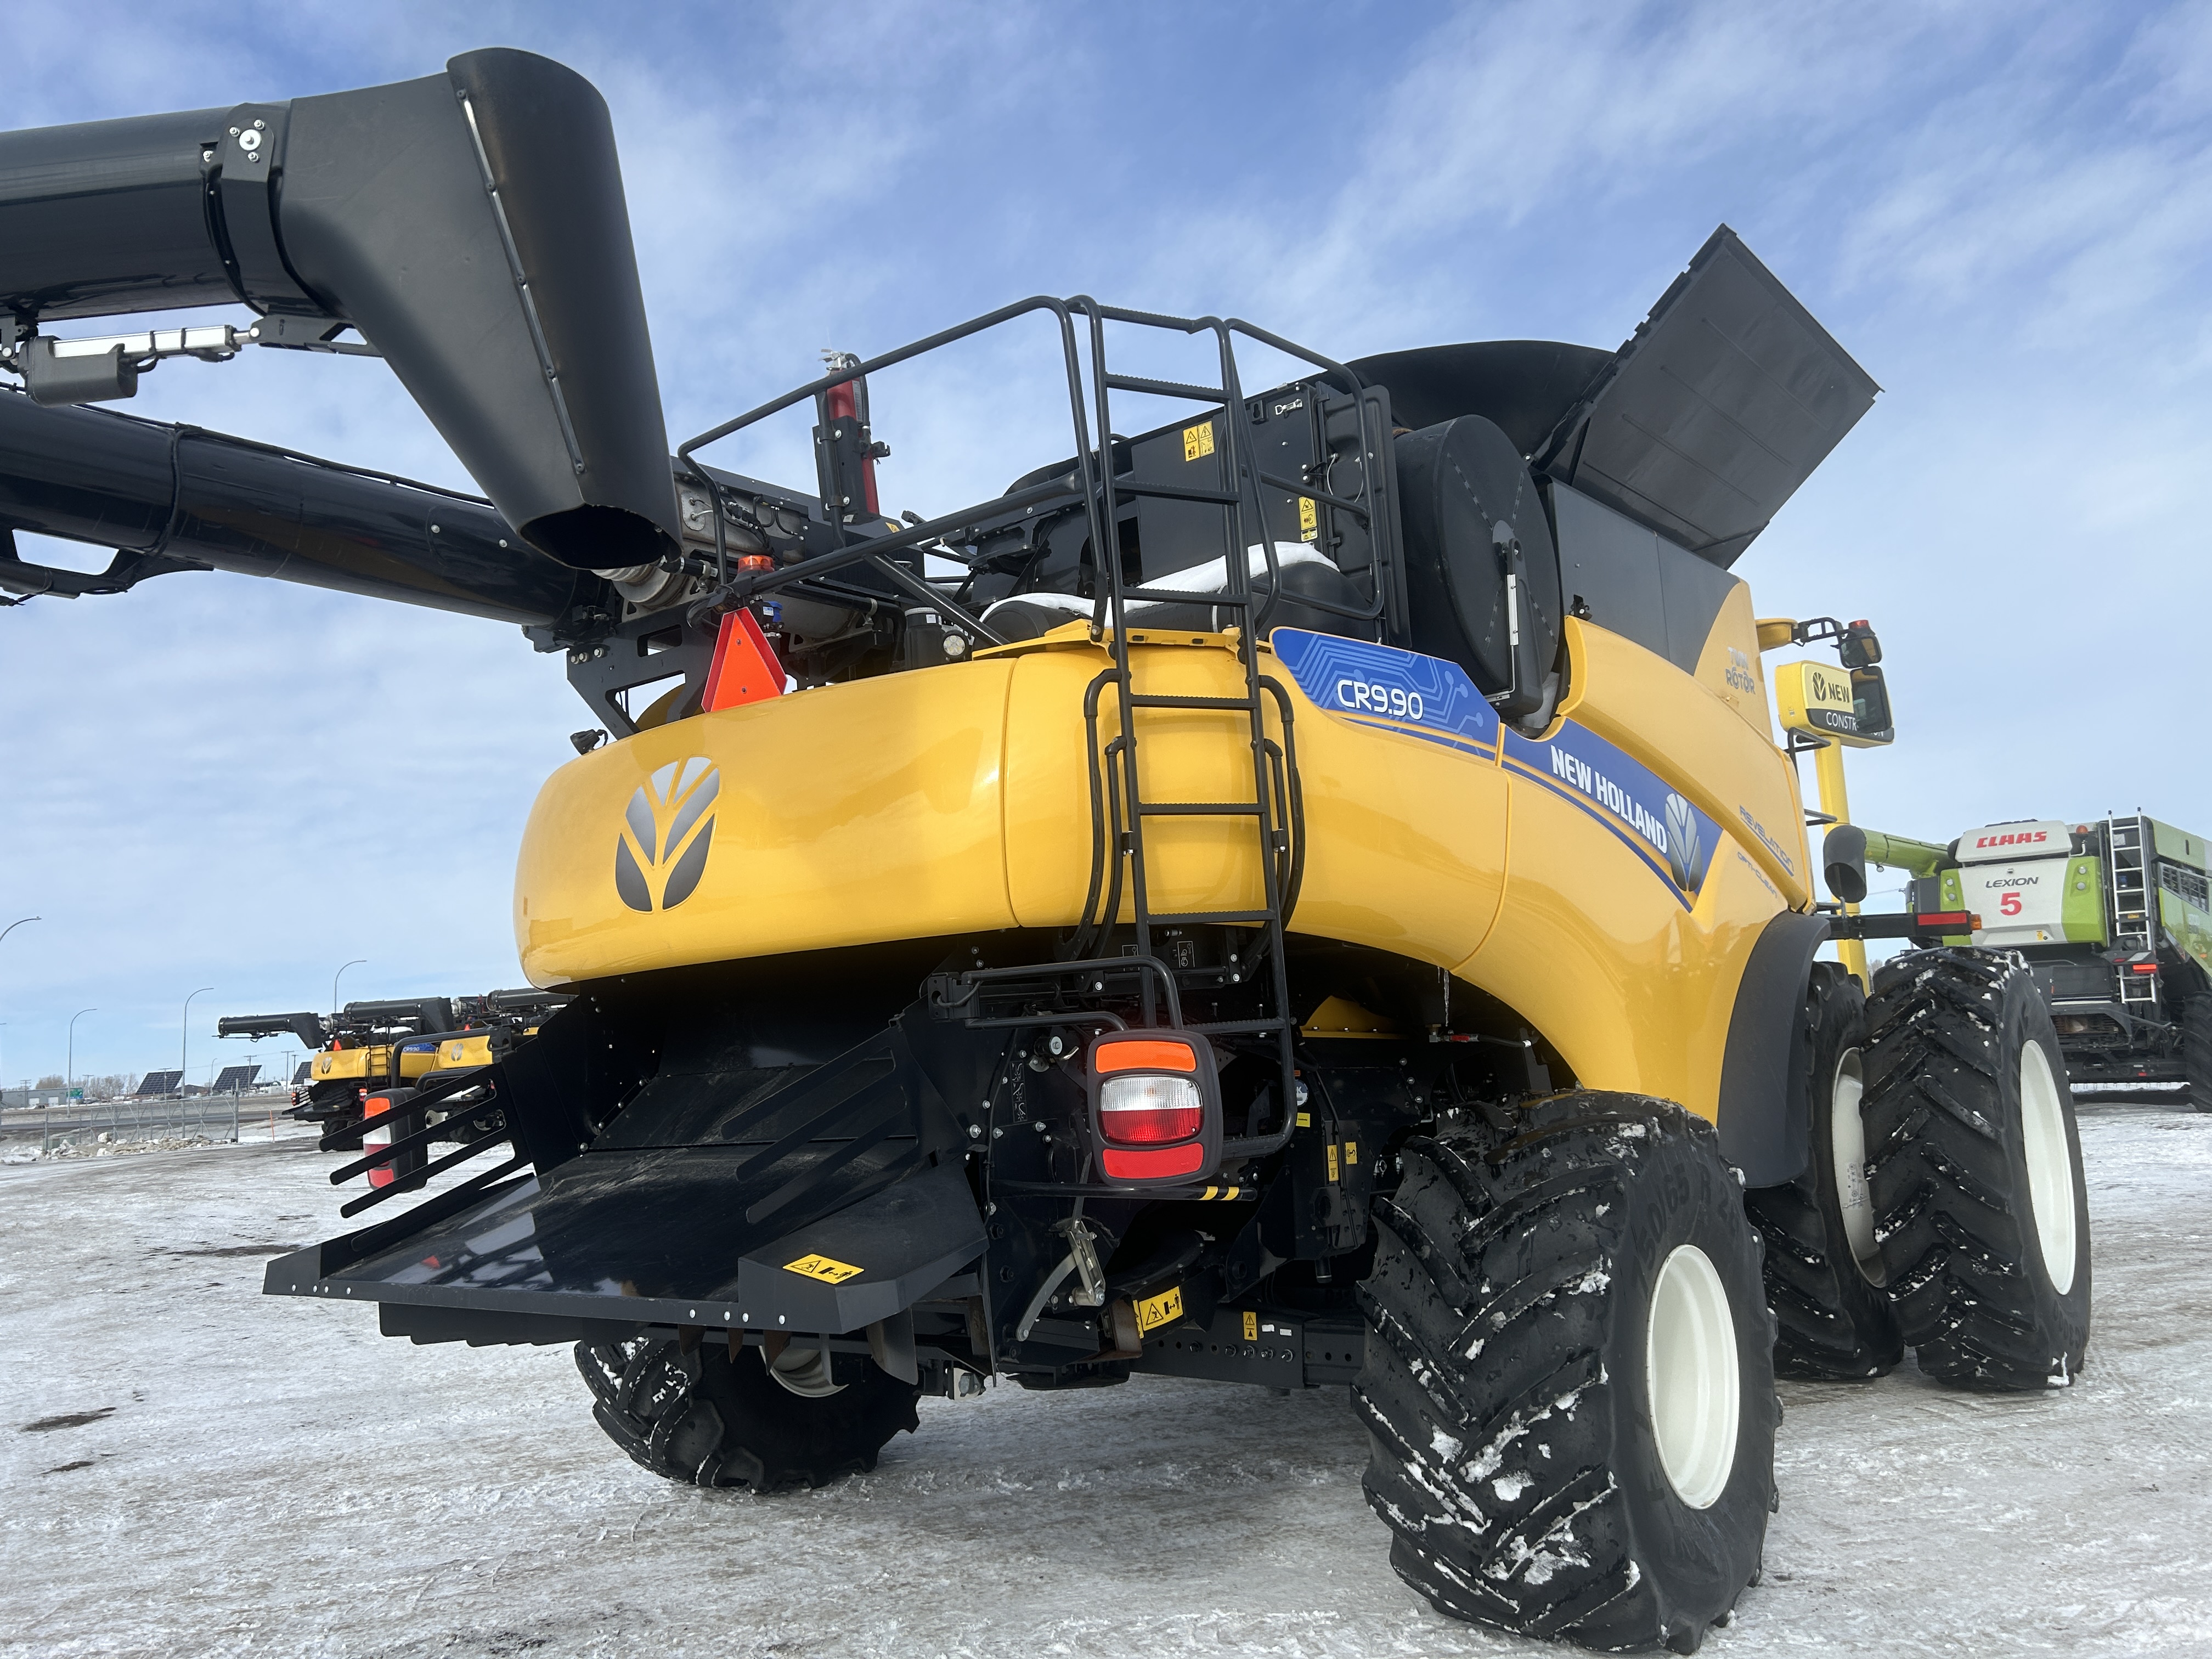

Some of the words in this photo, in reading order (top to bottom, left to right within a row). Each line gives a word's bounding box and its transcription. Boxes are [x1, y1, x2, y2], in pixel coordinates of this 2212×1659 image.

[1725, 666, 1756, 695] ROTOR
[1828, 682, 1850, 703] NEW
[1338, 679, 1423, 720] CR9.90
[1550, 744, 1592, 794] NEW
[1595, 771, 1667, 854] HOLLAND
[1740, 804, 1795, 872] REVELATION
[1976, 831, 2047, 848] CLAAS
[1985, 877, 2039, 888] LEXION
[2000, 892, 2022, 916] 5
